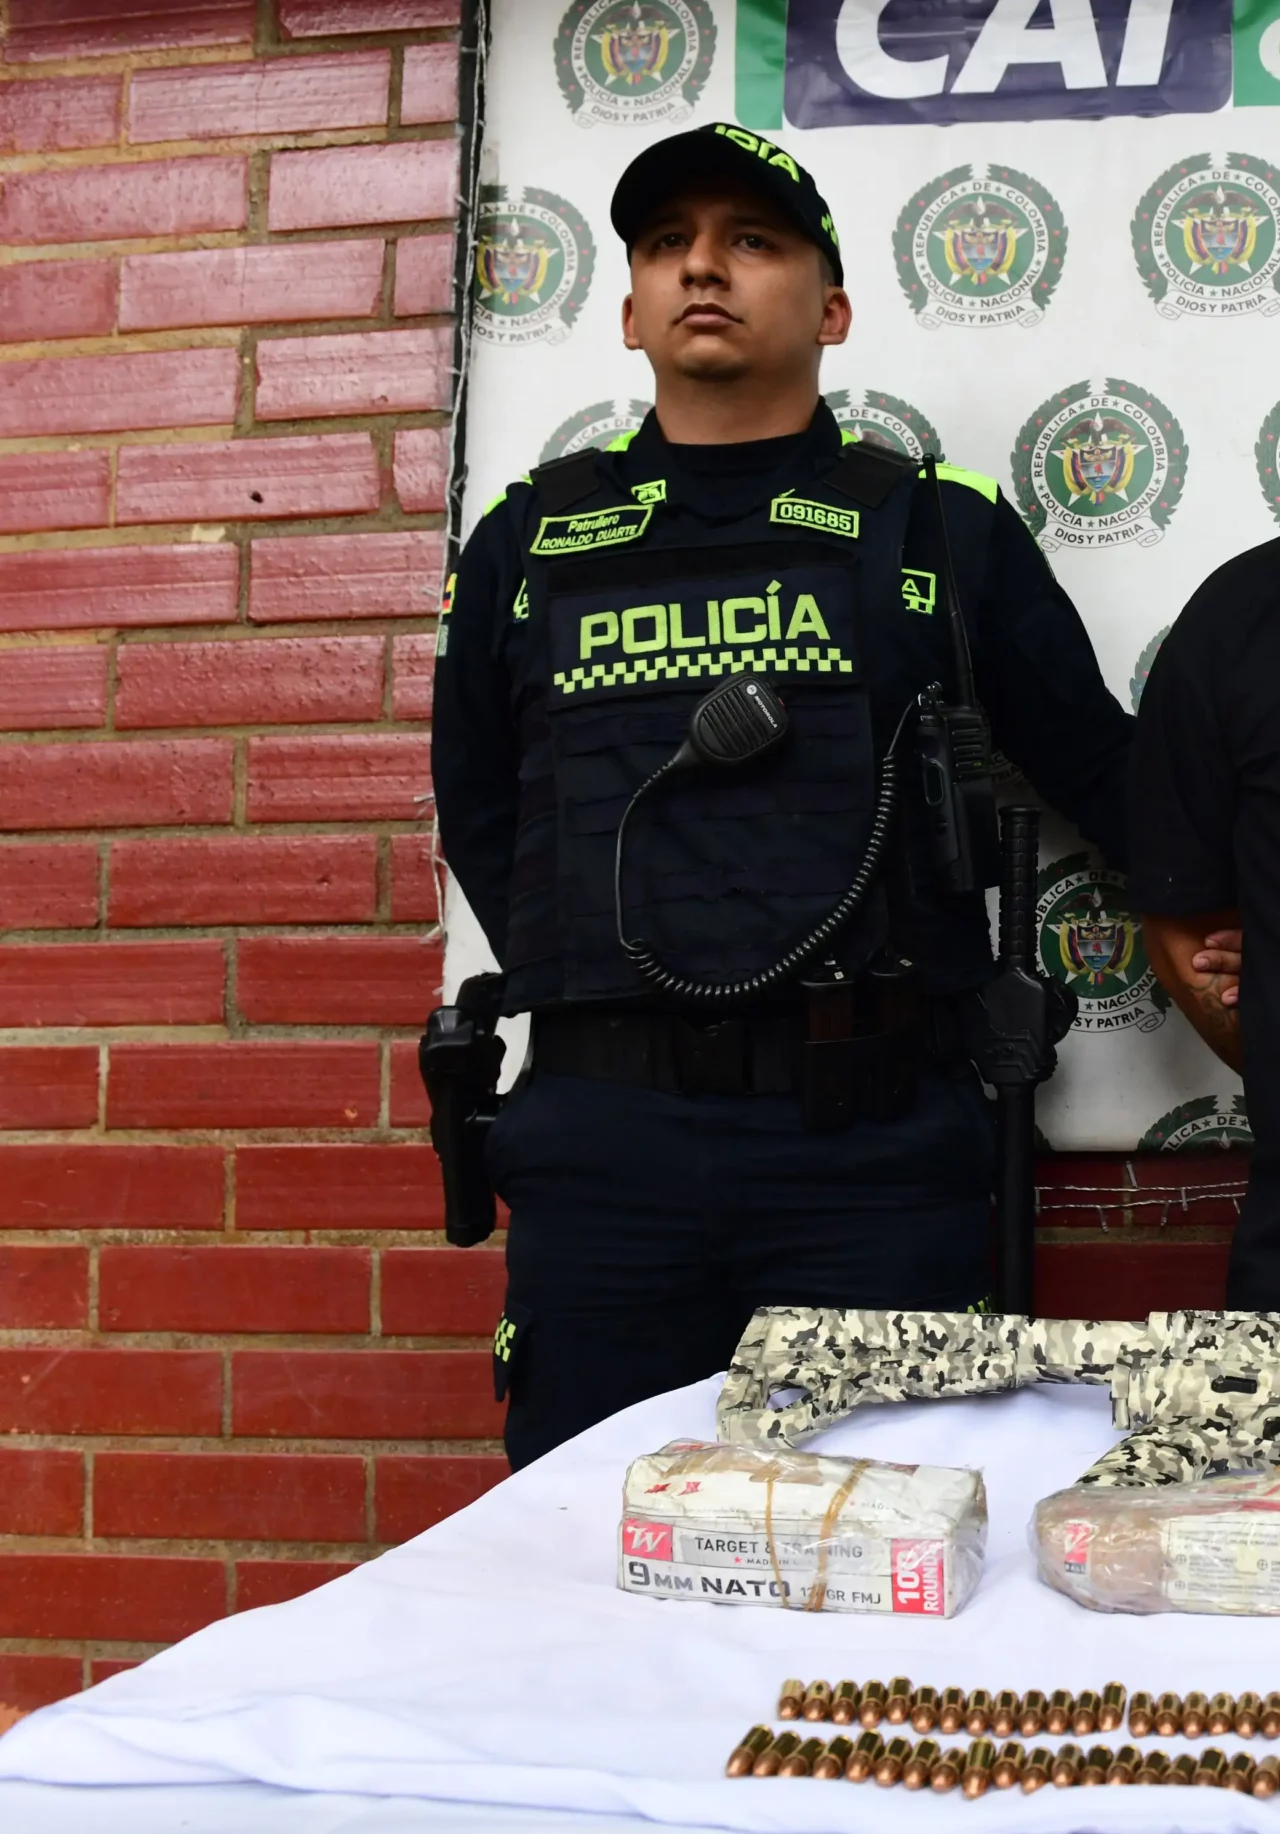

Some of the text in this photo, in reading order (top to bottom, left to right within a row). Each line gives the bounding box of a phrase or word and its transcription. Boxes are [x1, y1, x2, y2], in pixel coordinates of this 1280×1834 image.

[634, 67, 690, 106] NACIONAL
[591, 105, 619, 121] DIOS
[633, 102, 676, 122] PATRIA
[1212, 171, 1231, 180] DE
[973, 182, 992, 191] DE
[1005, 190, 1046, 252] COLOMBIA
[507, 204, 576, 272] DE COLOMBIA
[980, 268, 1040, 308] NACIONAL
[510, 288, 567, 327] NACIONAL
[936, 306, 965, 322] DIOS
[980, 304, 1025, 323] PATRIA
[1176, 296, 1206, 312] DIOS
[1221, 293, 1267, 313] PATRIA
[509, 323, 553, 342] PATRIA
[614, 418, 632, 428] DE
[850, 408, 921, 460] DE COLOM
[1090, 398, 1109, 407] DE
[1123, 403, 1166, 472] COLOMBIA
[780, 503, 852, 531] 091685
[1098, 486, 1160, 528] NACIONAL
[567, 515, 620, 533] Patrullero
[1054, 527, 1085, 544] DIOS
[1098, 523, 1144, 544] PATRIA
[541, 525, 638, 549] RONALDO DUARTE
[580, 579, 831, 660] POLICÍA
[755, 696, 778, 728] MOTOROLA
[1097, 969, 1155, 1011] NACIONA
[1097, 1007, 1145, 1028] PATRIA
[1217, 1116, 1237, 1126] DE
[695, 1537, 758, 1554] TARGET
[784, 1543, 863, 1558] TRANING
[747, 1558, 771, 1566] MAD
[702, 1577, 790, 1597] NATO
[827, 1590, 845, 1601] GR
[852, 1592, 881, 1604] FMJ
